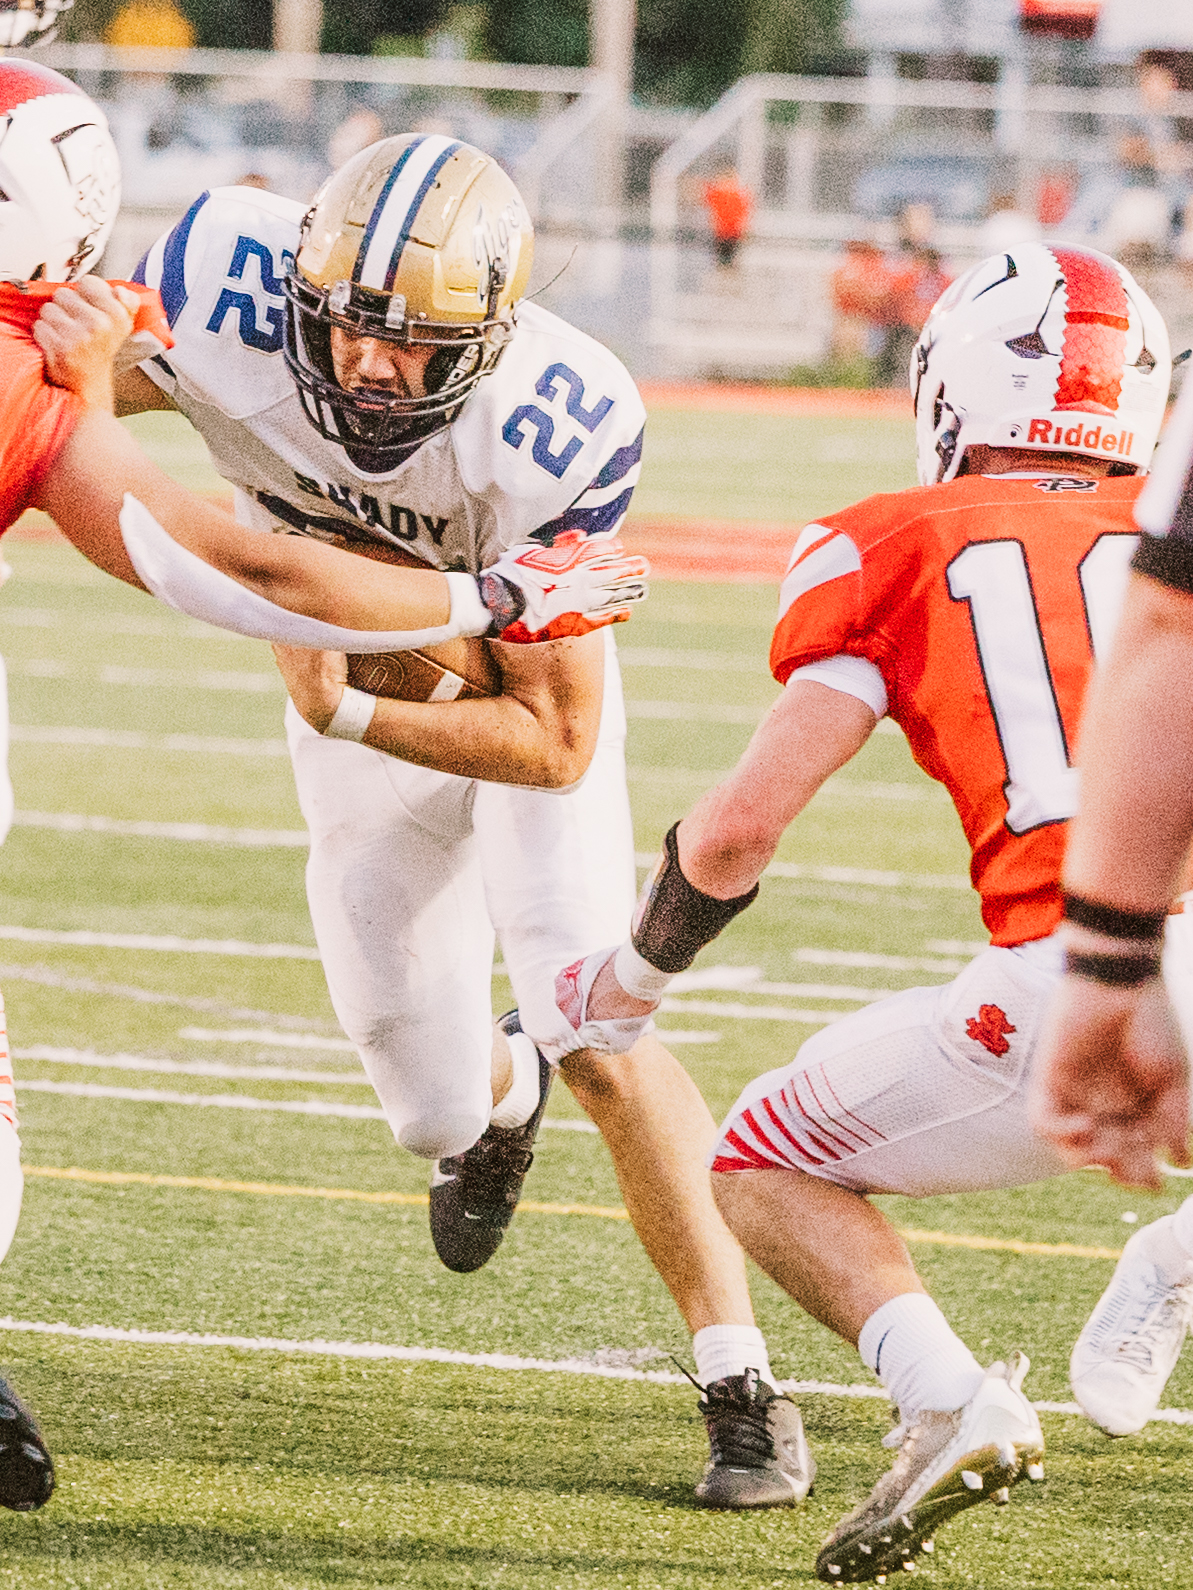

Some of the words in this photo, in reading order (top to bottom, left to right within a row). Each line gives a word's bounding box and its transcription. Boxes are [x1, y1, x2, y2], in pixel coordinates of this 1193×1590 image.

[205, 234, 295, 353] 22
[501, 362, 616, 480] 22
[1027, 418, 1135, 456] Riddell
